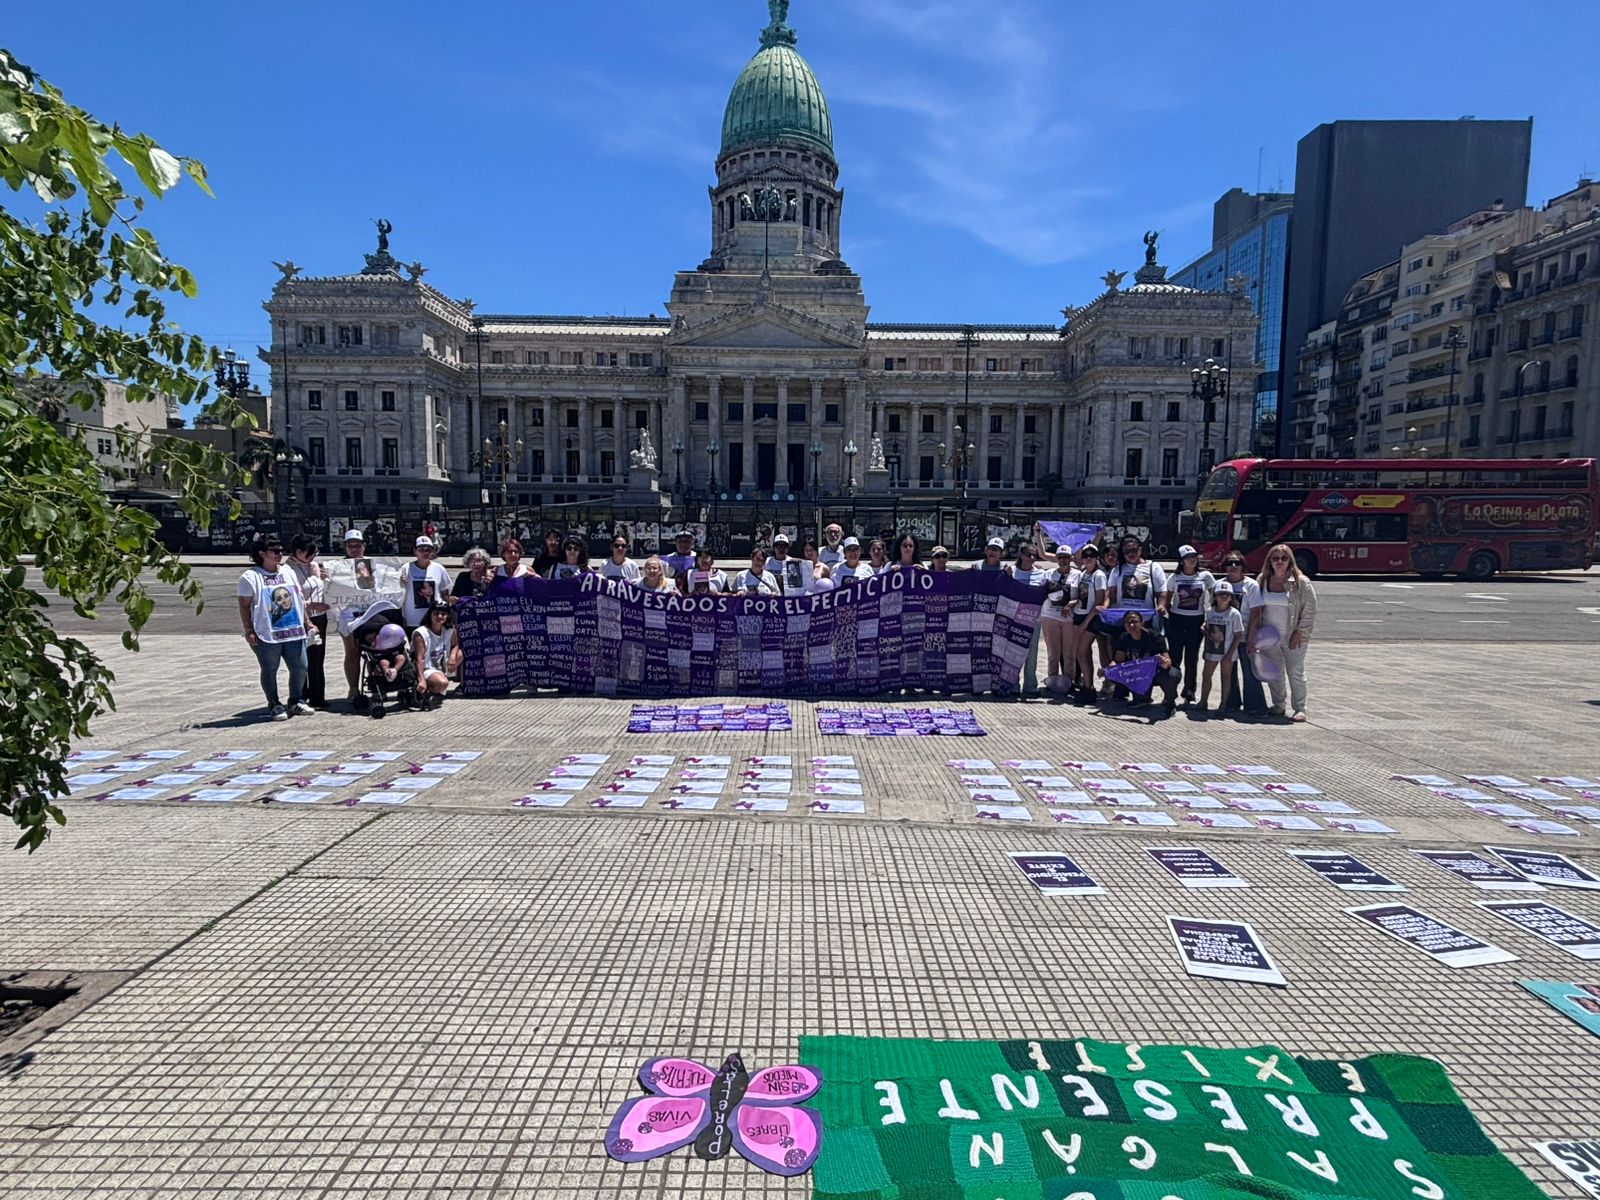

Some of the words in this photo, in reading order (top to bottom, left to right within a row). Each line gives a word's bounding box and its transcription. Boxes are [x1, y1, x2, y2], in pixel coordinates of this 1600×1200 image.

[1523, 508, 1540, 521] del
[581, 572, 727, 613] ATRAVESADOS
[744, 598, 780, 615] POR
[784, 598, 806, 615] EL
[811, 571, 935, 613] FEMICIDIO
[575, 618, 596, 626] LUNA
[691, 615, 715, 624] NADIA
[575, 626, 599, 636] ORTIZ
[505, 643, 522, 652] CRUZ
[1217, 958, 1259, 966] NUNCA
[1027, 1041, 1367, 1093] EXISTE
[879, 1072, 1389, 1140] PRESENTE
